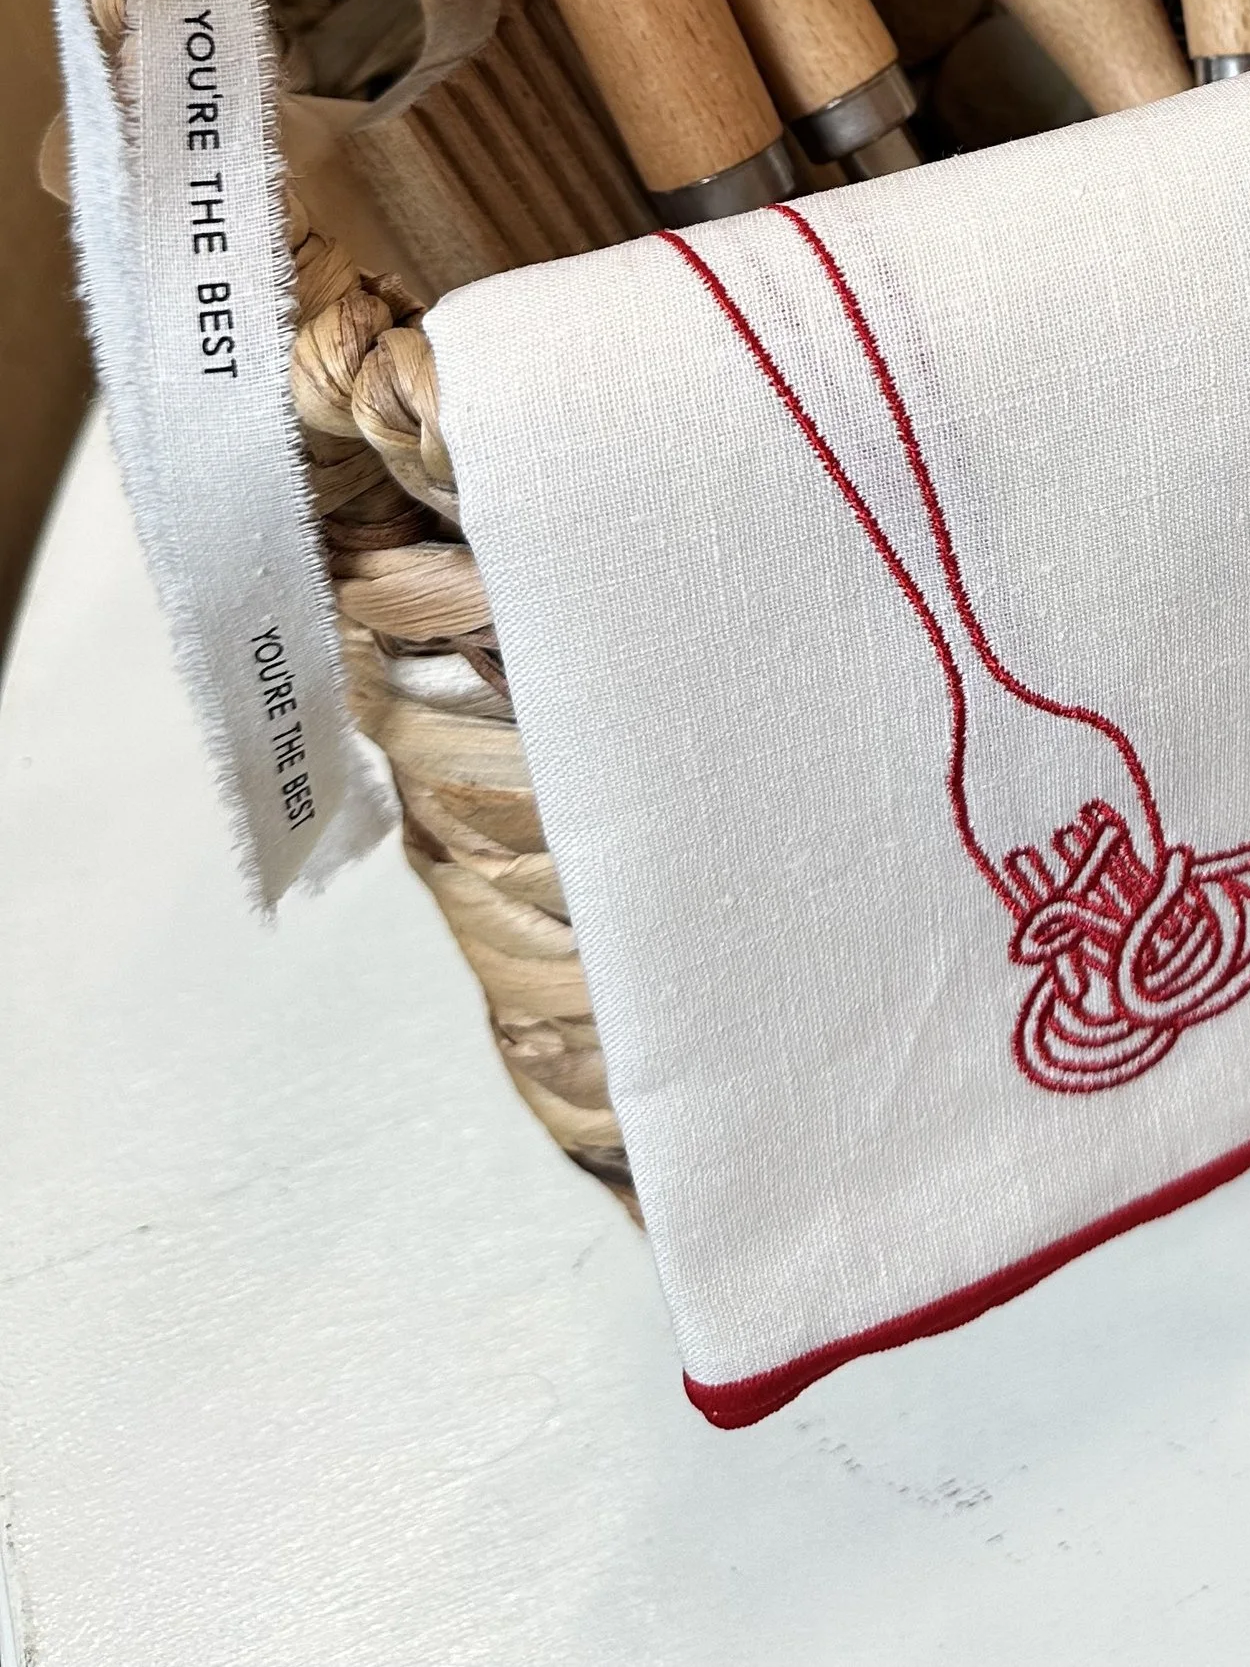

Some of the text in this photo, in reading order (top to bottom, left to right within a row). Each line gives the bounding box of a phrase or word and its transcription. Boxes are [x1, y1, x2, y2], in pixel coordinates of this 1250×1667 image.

[184, 9, 239, 379] YOU'RE THE BEST
[250, 624, 318, 832] YOU'RE THE BEST
